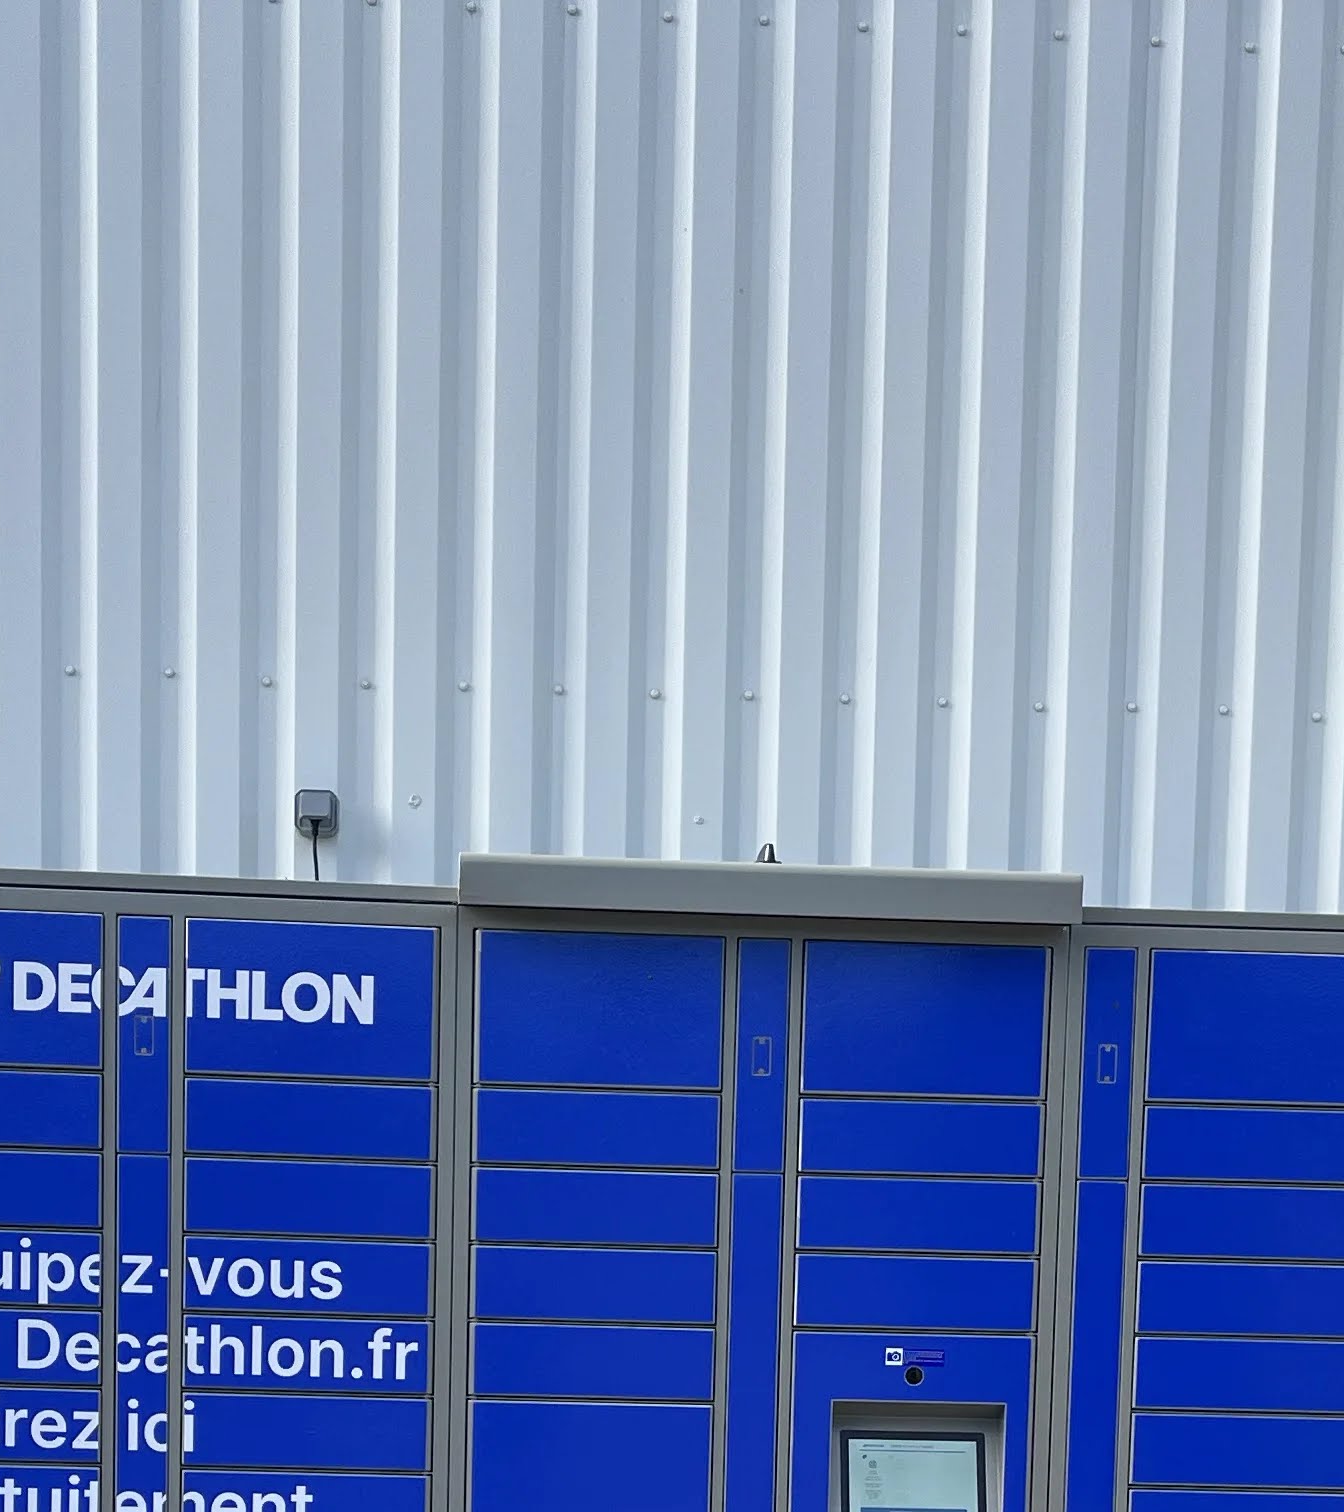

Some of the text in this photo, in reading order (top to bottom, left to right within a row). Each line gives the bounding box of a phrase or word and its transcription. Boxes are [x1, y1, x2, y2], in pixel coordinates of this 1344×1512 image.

[13, 960, 374, 1025] DECATHLON
[17, 1318, 419, 1380] Decathlon.fr
[127, 1398, 195, 1453] ici
